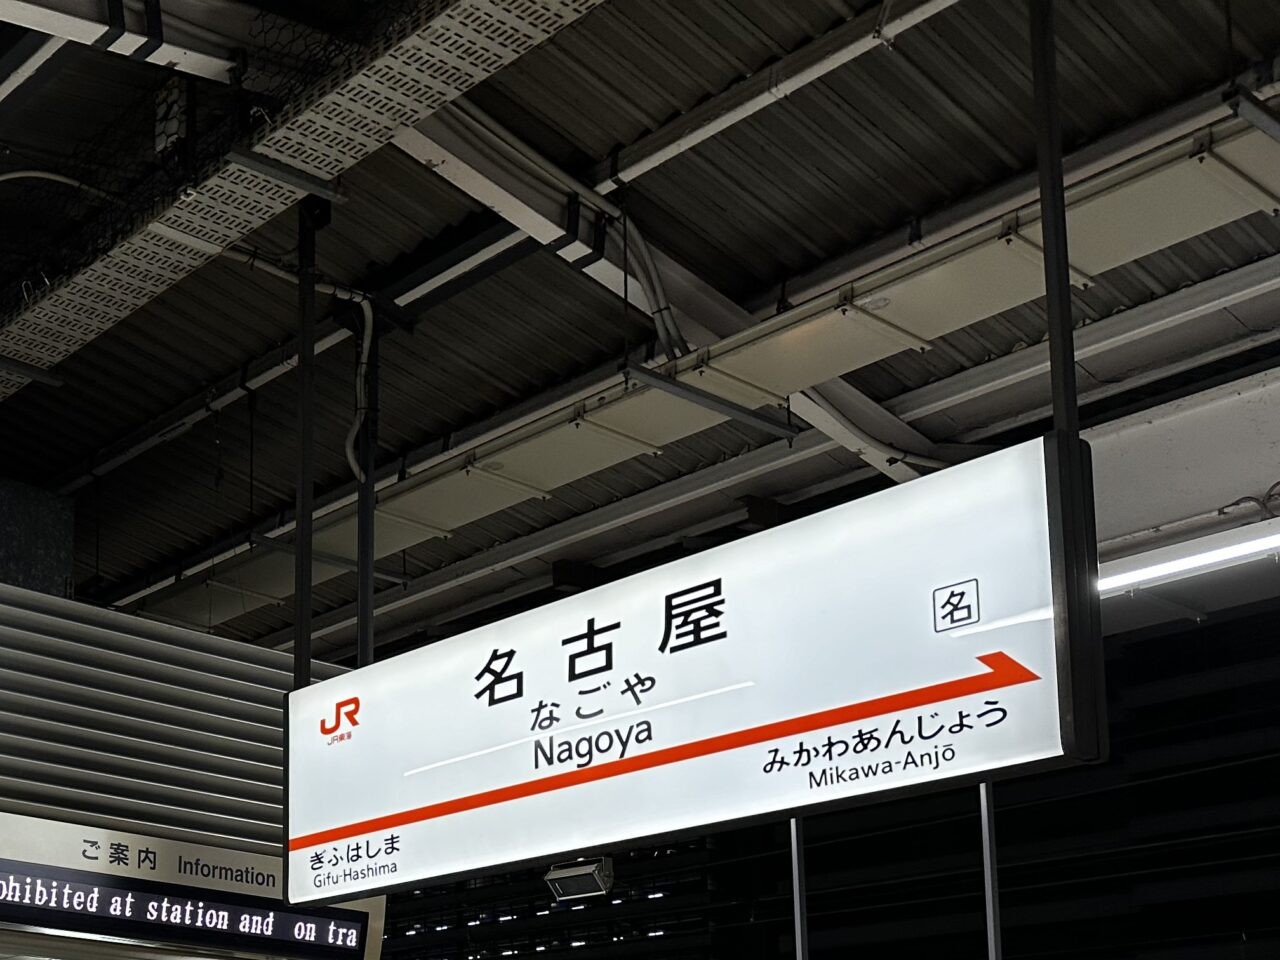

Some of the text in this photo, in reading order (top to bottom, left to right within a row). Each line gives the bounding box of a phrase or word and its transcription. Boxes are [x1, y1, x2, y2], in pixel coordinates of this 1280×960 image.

[940, 588, 974, 627] 名
[473, 577, 728, 708] 名古屋
[320, 696, 360, 735] JR
[530, 672, 657, 732] なごや
[533, 718, 653, 768] Nagoya
[762, 700, 1009, 775] みかわあんじょう
[807, 743, 957, 791] Mikawa-Anjō
[81, 838, 157, 871] ご案内
[177, 854, 277, 888] Information
[309, 833, 401, 871] ぎふはしま
[313, 858, 398, 889] Gifu-Hashima
[110, 897, 134, 920] at
[146, 897, 230, 931] station
[238, 911, 275, 937] and
[293, 919, 317, 942] on
[327, 921, 358, 948] tra
